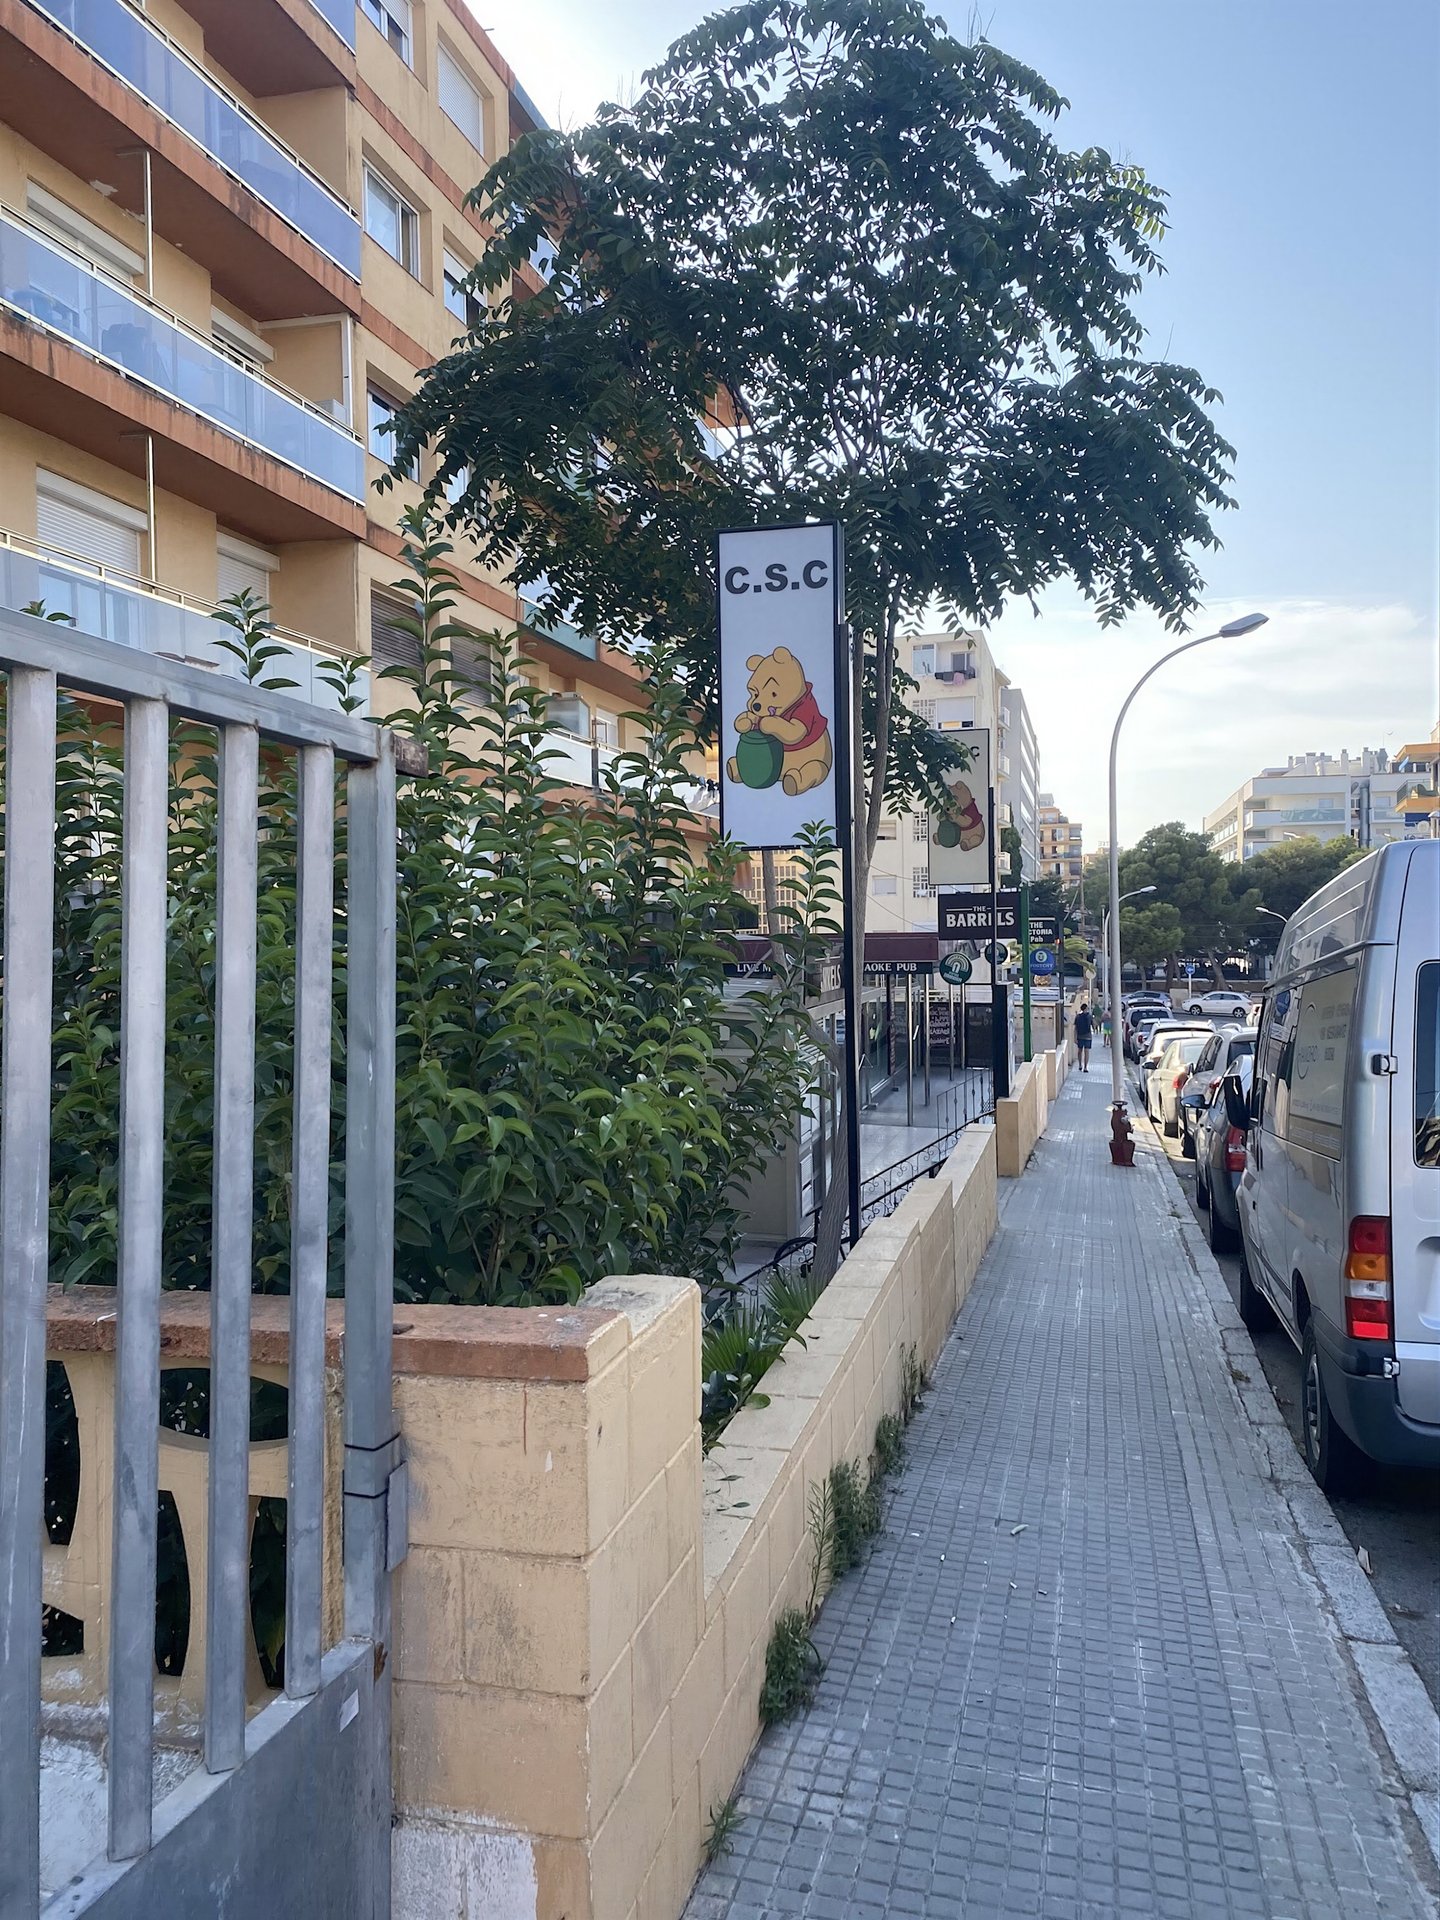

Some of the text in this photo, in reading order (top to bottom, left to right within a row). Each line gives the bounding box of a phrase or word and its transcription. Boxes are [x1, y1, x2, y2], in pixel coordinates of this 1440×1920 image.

[724, 559, 829, 595] C.S.C
[1030, 921, 1044, 929] THE
[1029, 928, 1053, 936] CTORIA
[864, 962, 892, 972] AOKE
[896, 962, 918, 972] PUB
